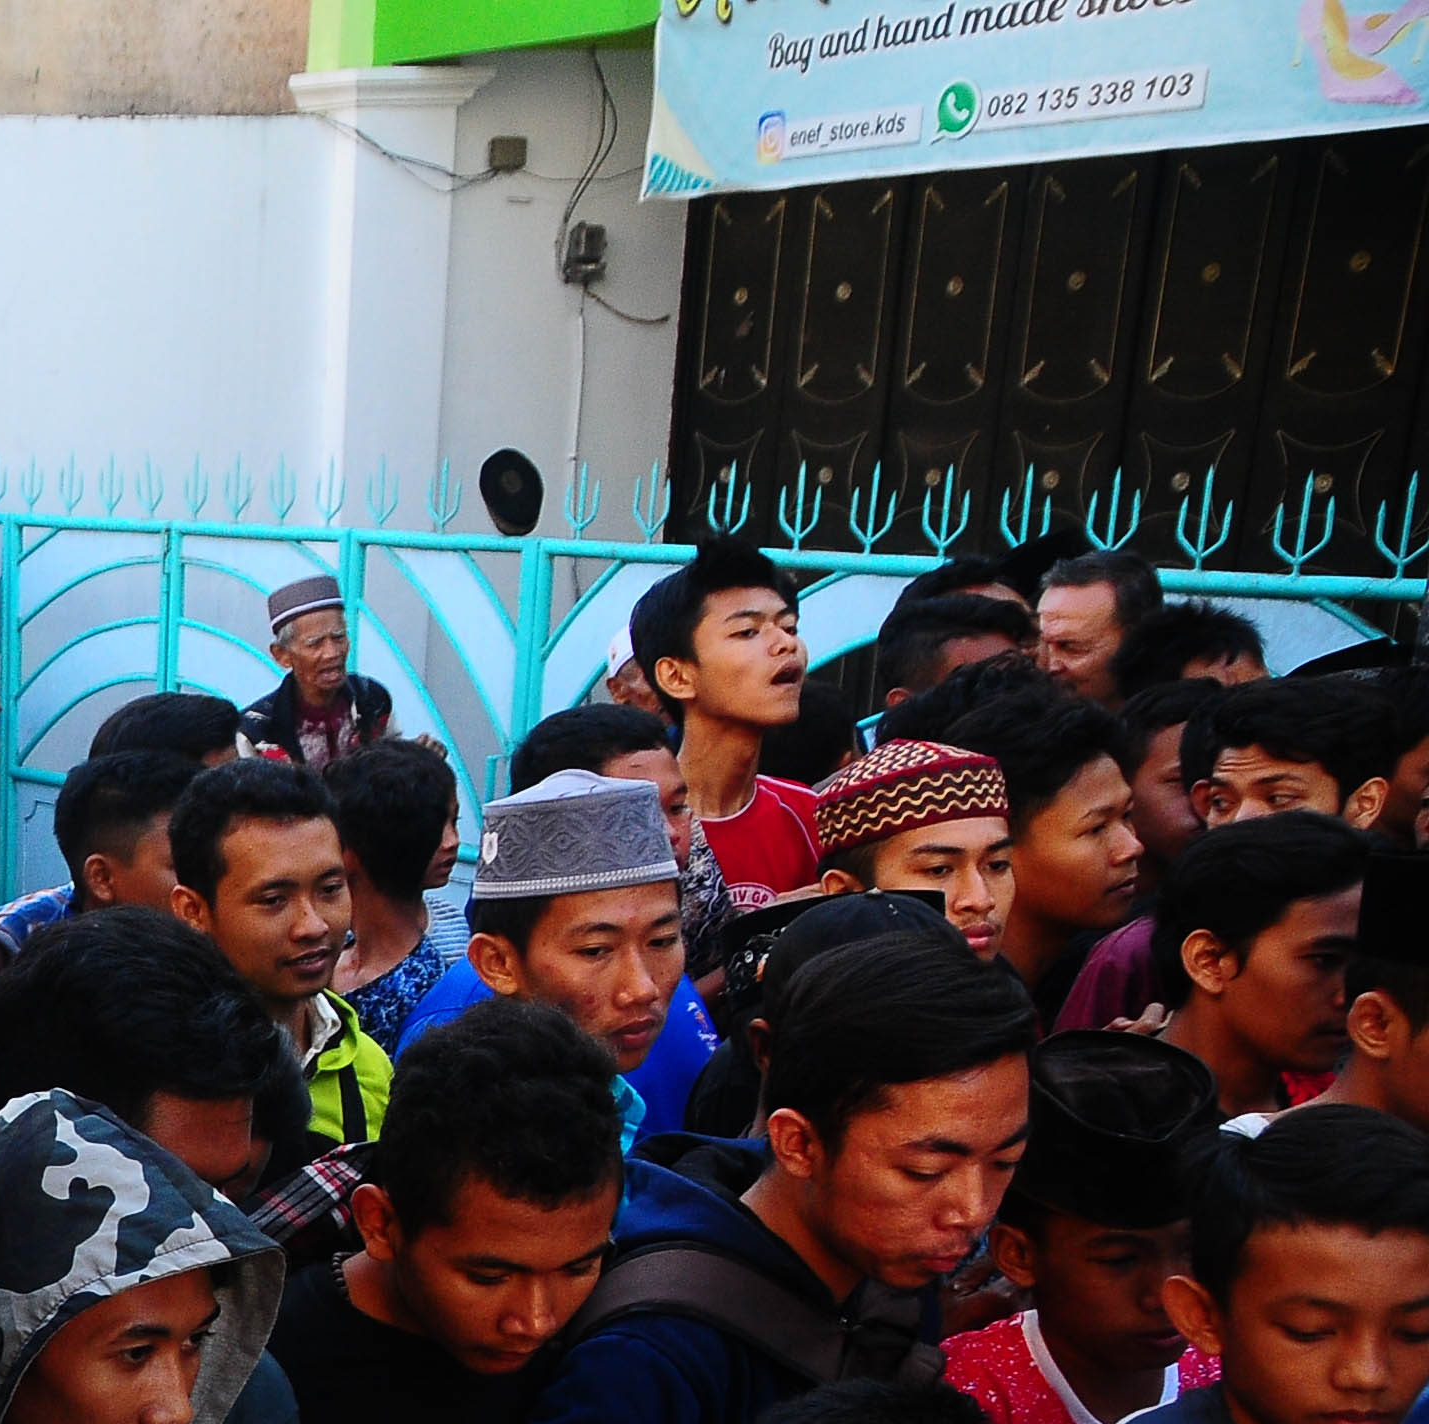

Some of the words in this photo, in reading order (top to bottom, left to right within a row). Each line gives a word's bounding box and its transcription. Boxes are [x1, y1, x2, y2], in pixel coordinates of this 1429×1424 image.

[768, 33, 811, 73] Bag
[819, 18, 869, 59] and
[872, 2, 952, 49] hand
[959, 0, 1064, 36] made
[987, 94, 1027, 119] 082
[1036, 86, 1079, 113] 135
[1086, 79, 1134, 107] 338
[1144, 72, 1195, 100] 103
[789, 112, 907, 148] enef_store.kds
